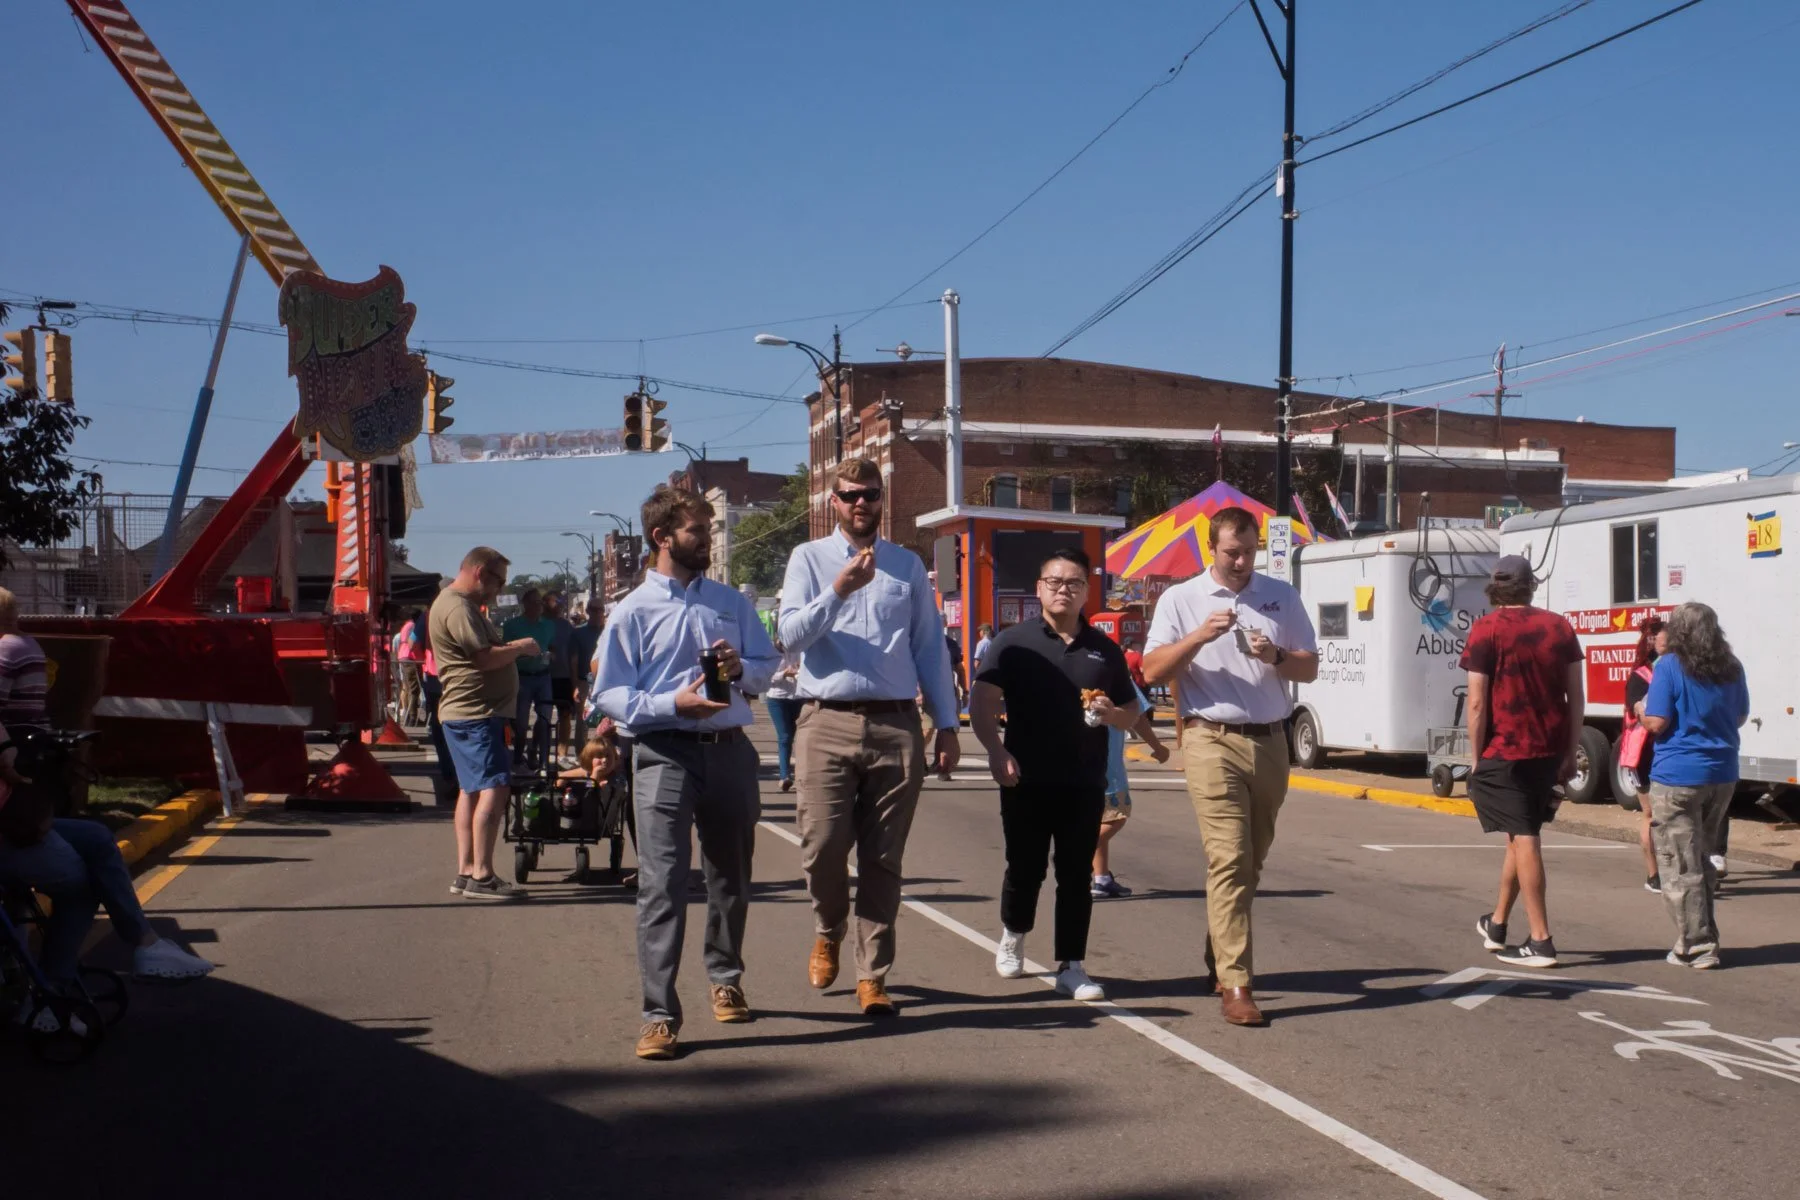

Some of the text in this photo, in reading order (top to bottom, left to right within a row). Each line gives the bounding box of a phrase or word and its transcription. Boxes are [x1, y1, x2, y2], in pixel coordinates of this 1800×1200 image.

[1757, 523, 1773, 546] 18
[1579, 610, 1611, 632] Original
[1327, 641, 1366, 665] Council
[1416, 634, 1465, 655] Abus
[1448, 660, 1457, 670] of
[1319, 667, 1366, 687] rburgh County
